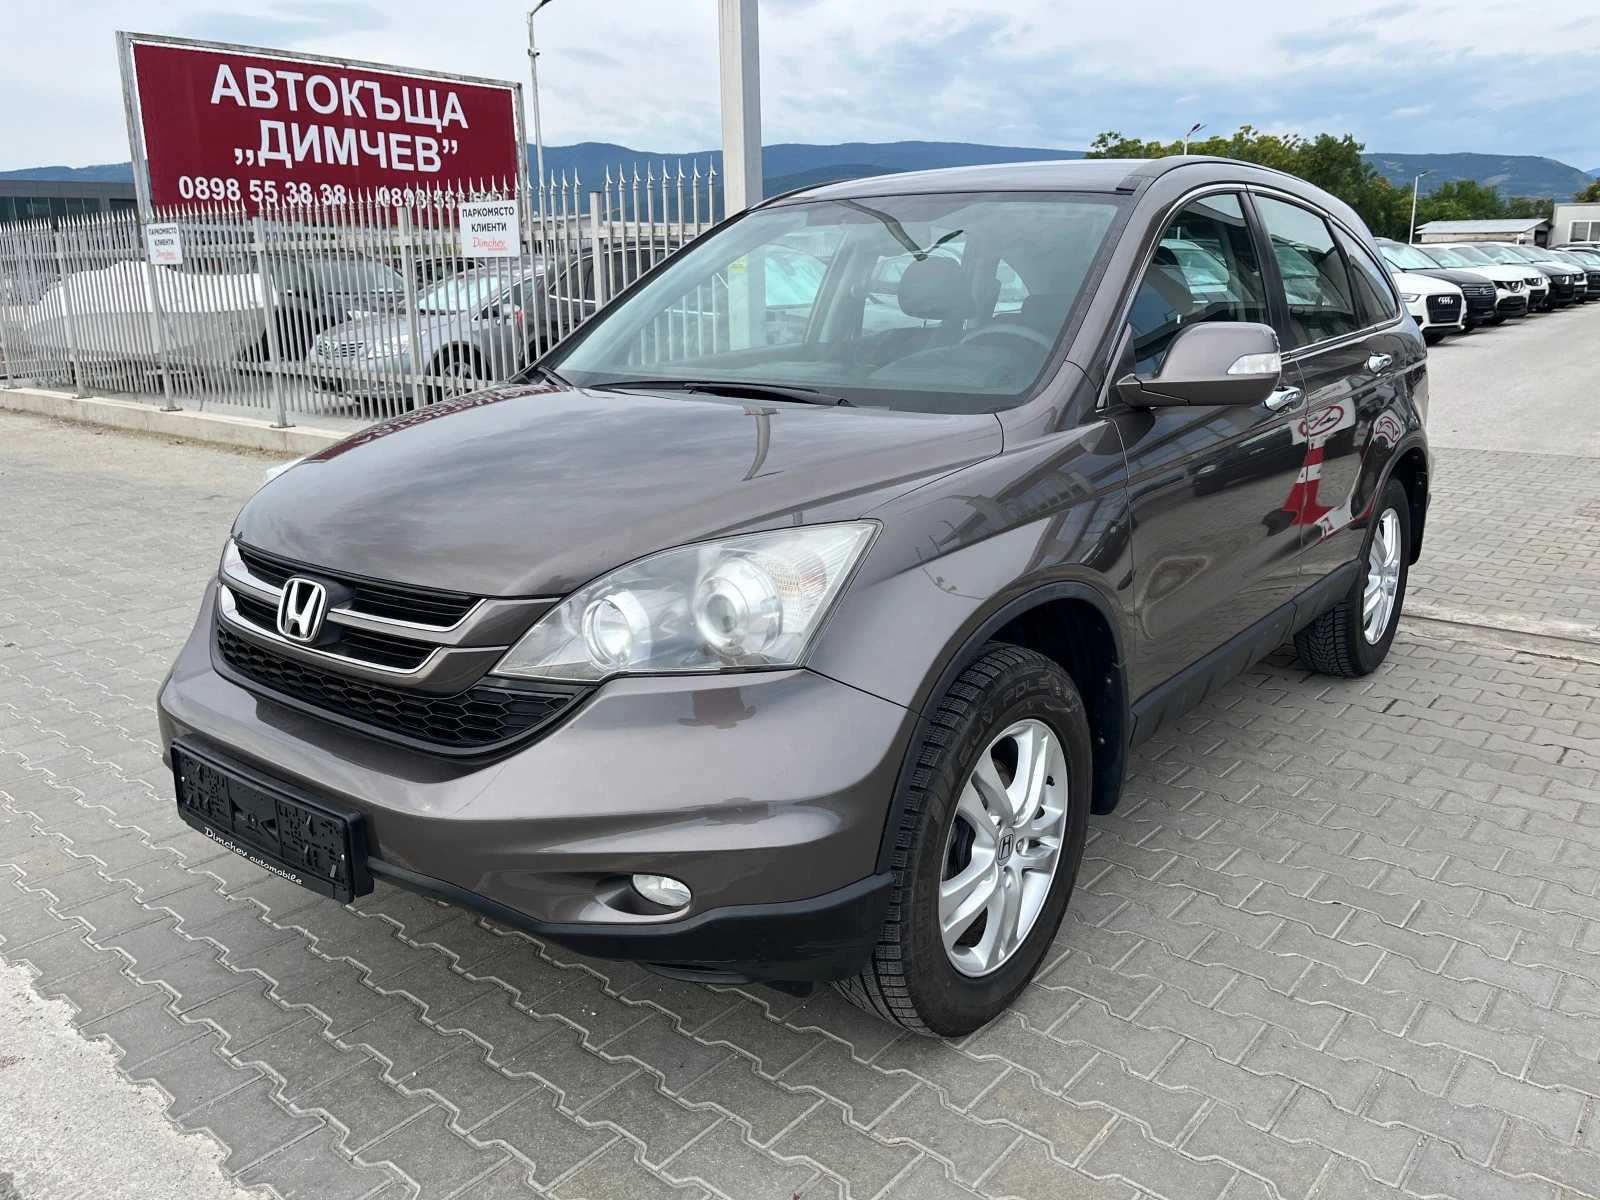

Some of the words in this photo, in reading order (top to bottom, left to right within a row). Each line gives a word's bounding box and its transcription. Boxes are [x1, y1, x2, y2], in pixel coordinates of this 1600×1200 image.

[210, 64, 469, 132] АВТОКЪЩА
[178, 175, 241, 201] 0898
[249, 179, 278, 203] 55
[285, 181, 313, 205] 38
[319, 183, 347, 206] 38
[462, 206, 515, 218] ПАРКОМЯСТО
[471, 222, 507, 233] КЛИЕНТИ
[473, 236, 506, 248] Dimchev
[204, 826, 248, 857] Dimchev
[249, 854, 303, 886] automobile
